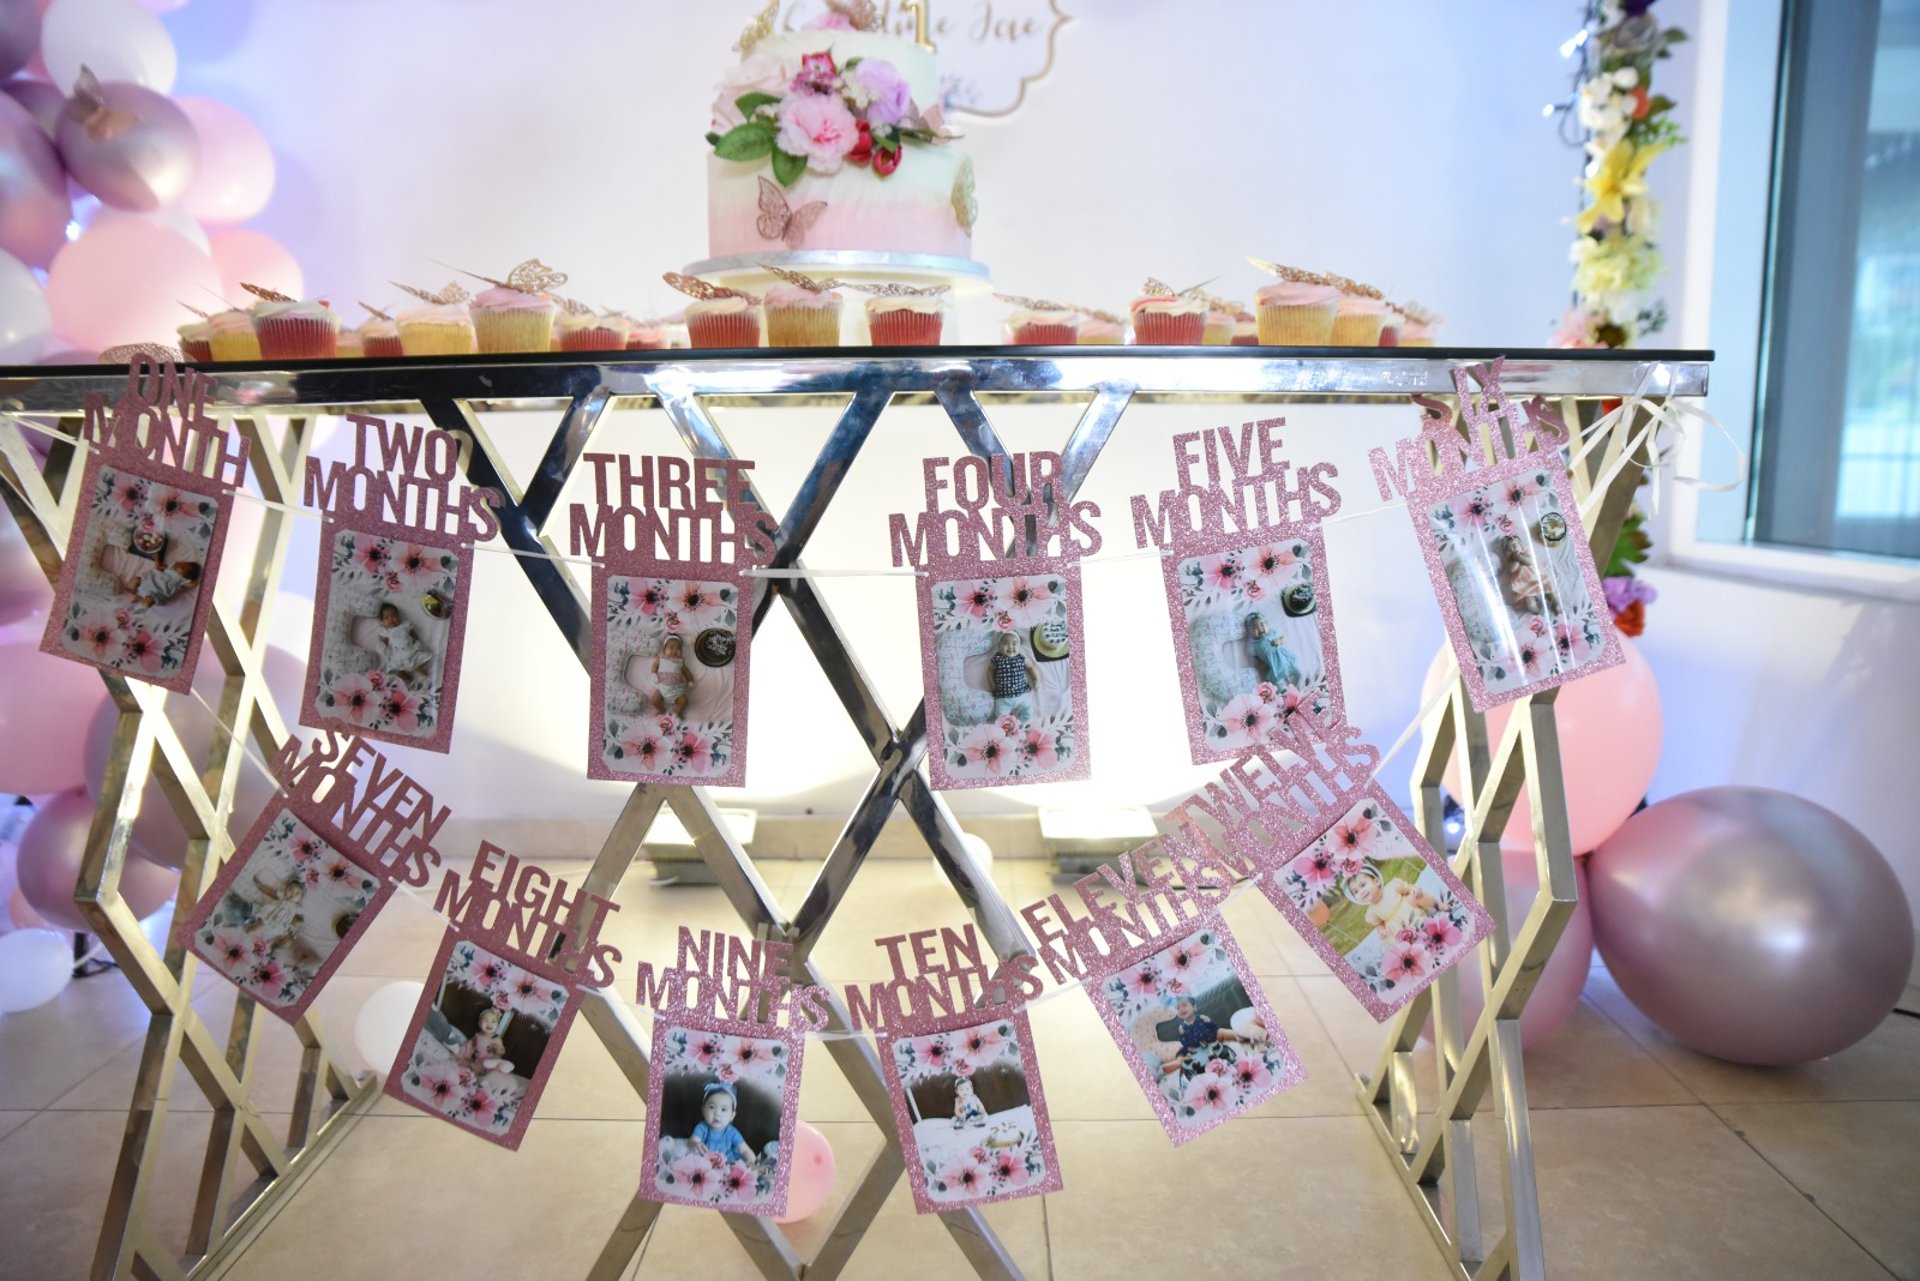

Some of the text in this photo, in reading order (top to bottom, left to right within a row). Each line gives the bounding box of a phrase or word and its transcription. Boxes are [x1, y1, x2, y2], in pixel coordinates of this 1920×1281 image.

[127, 352, 218, 422] ONE
[1410, 355, 1508, 424] SIX
[84, 391, 251, 488] MONTH
[345, 413, 458, 484] TWO
[583, 452, 756, 510] THREE
[922, 450, 1064, 512] FOUR
[1173, 417, 1291, 494] FIVE
[1368, 395, 1569, 503] MONTHS
[304, 455, 500, 543] MONTHS
[569, 503, 780, 568] MONTHS
[889, 500, 1102, 568] MONTHS
[1130, 462, 1342, 549] MONTHS
[268, 733, 442, 888] MONTHS
[312, 729, 452, 848] SEVEN
[1163, 690, 1341, 856] TWELVE
[1204, 725, 1381, 886] MONTHS
[469, 840, 622, 935] EIGHT
[1020, 821, 1205, 948] ELEVEN
[1036, 862, 1232, 985] MONTHS
[433, 869, 623, 988] MONTHS
[677, 925, 794, 983] NINE
[875, 923, 982, 983] TEN
[636, 959, 829, 1032] MONTHS
[844, 953, 1045, 1032] MONTHS
